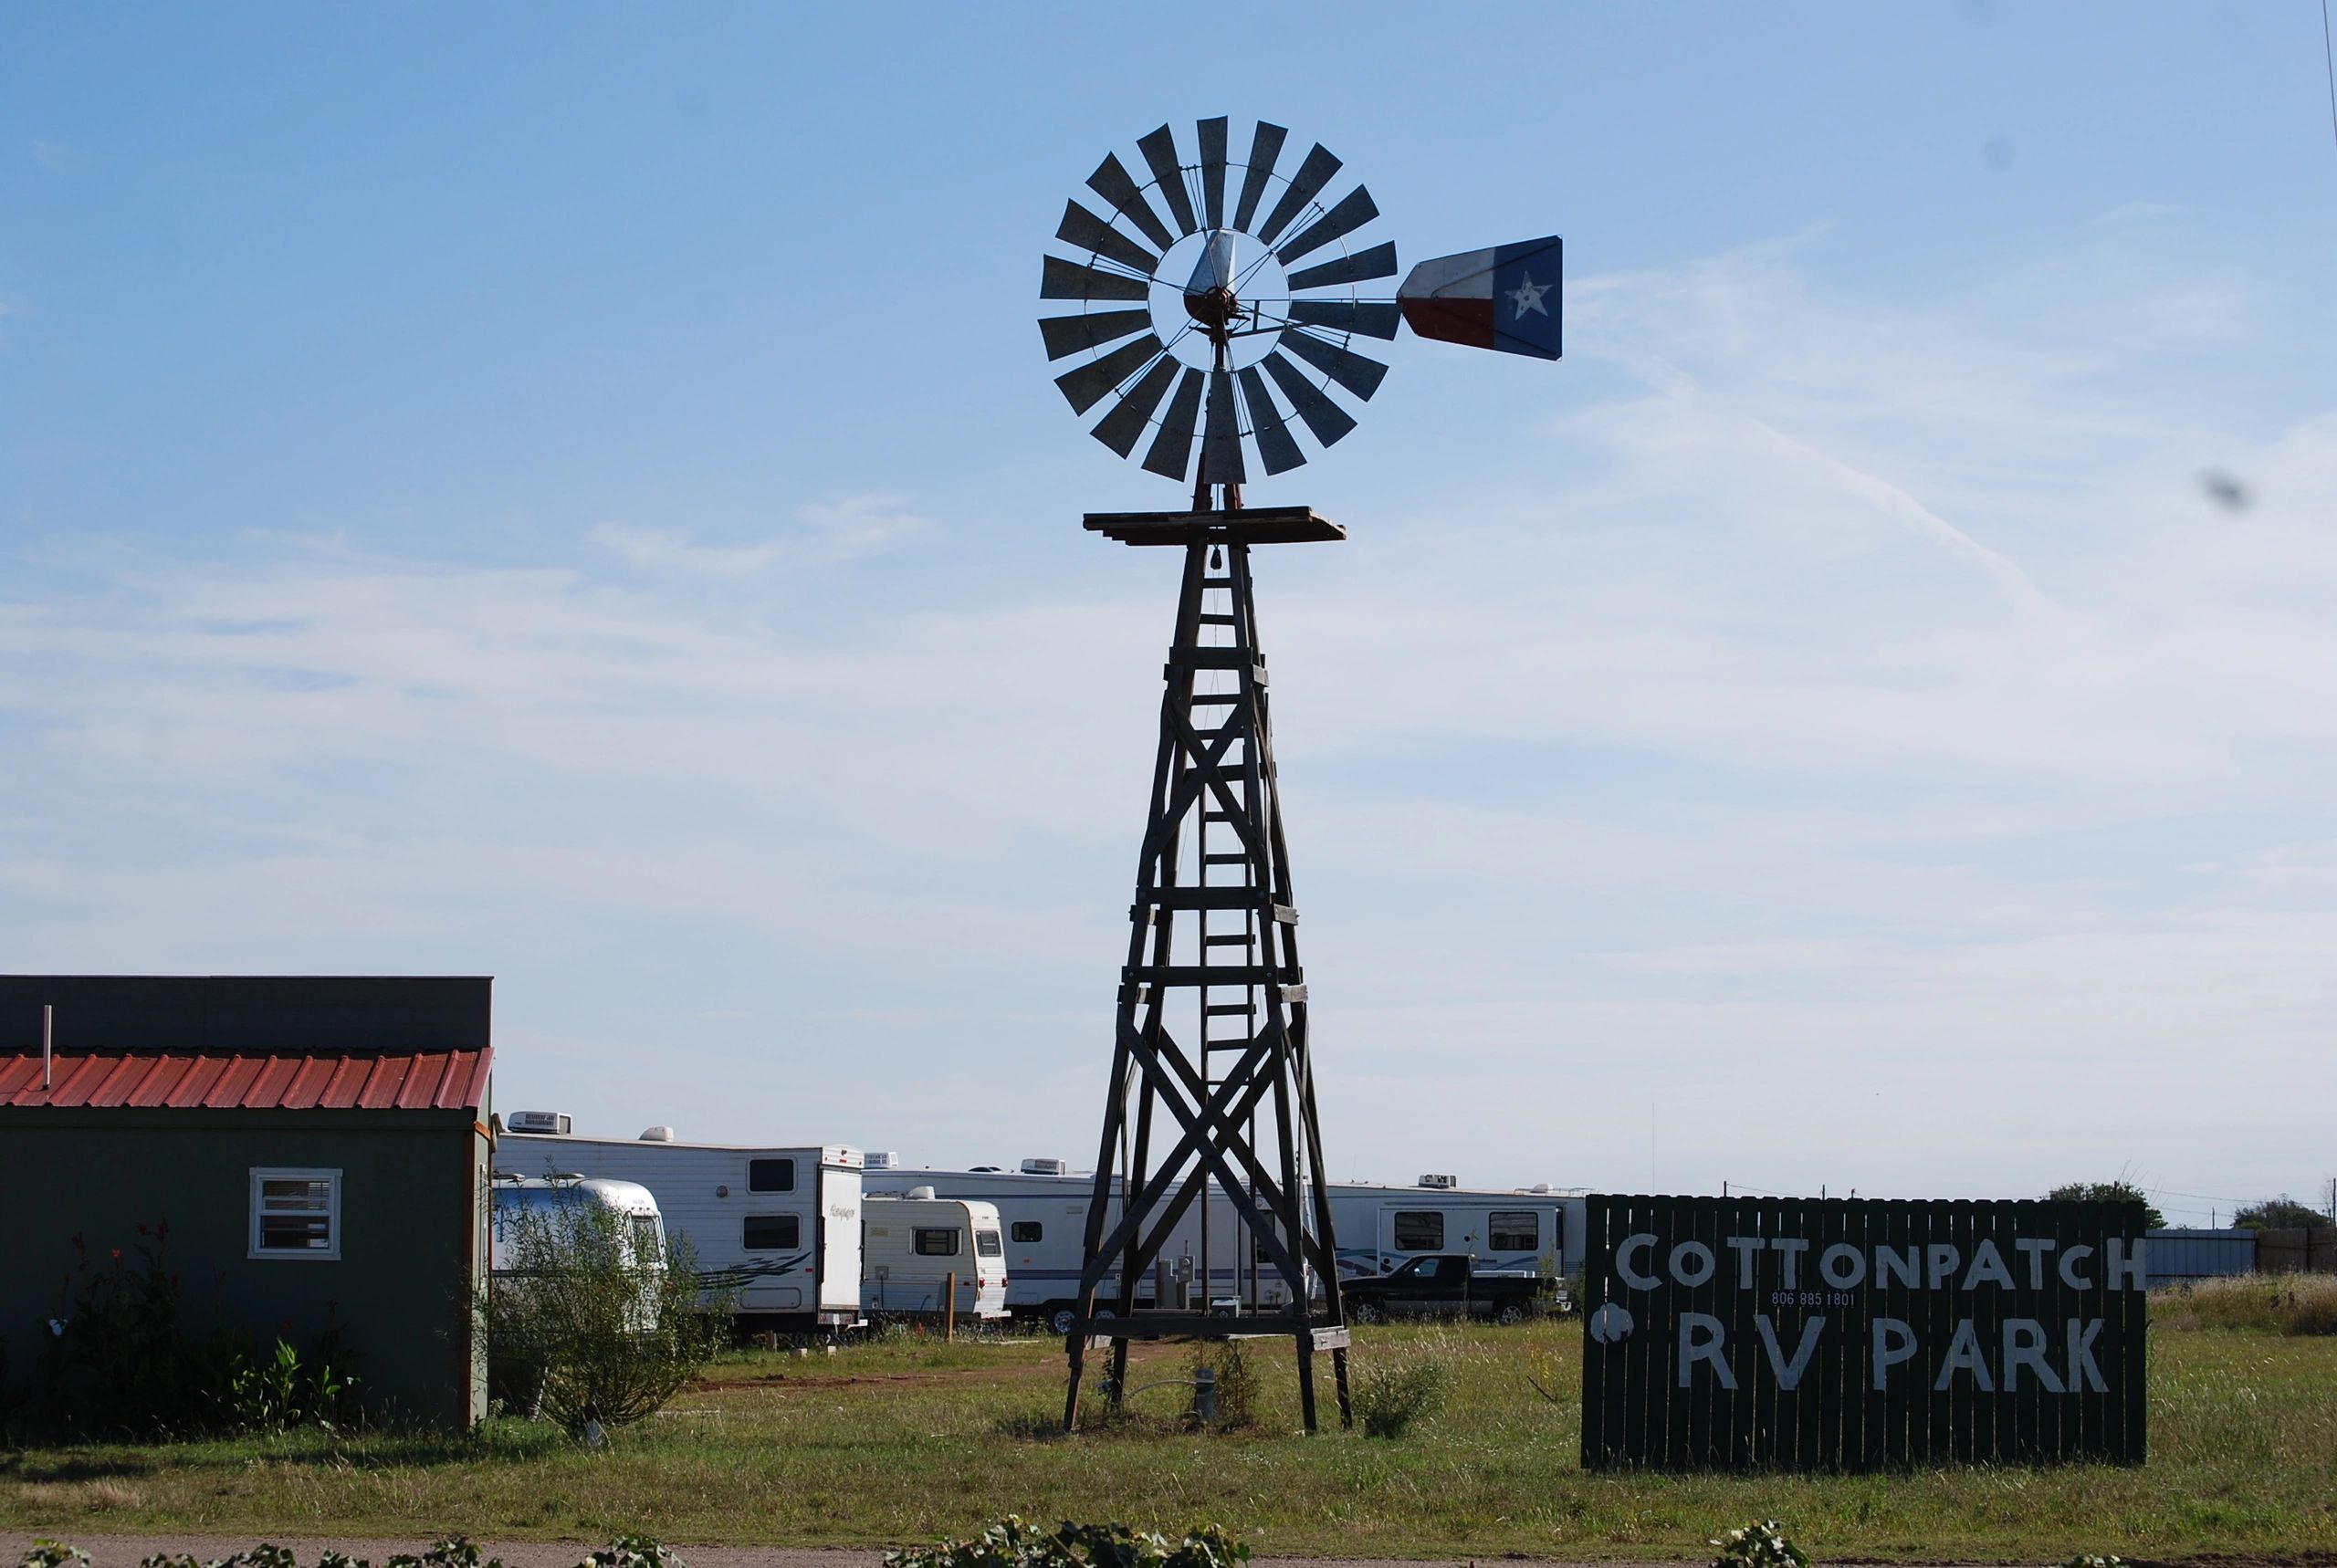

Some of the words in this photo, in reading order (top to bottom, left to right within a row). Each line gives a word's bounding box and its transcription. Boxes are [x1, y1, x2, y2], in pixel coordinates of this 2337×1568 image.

[1615, 1233, 2146, 1291] COTTONPATCH
[1771, 1291, 1795, 1305] 806
[1799, 1292, 1822, 1305] 885
[1827, 1292, 1854, 1306] 1801
[1678, 1312, 1826, 1390] RV
[1871, 1317, 2110, 1393] PARK
